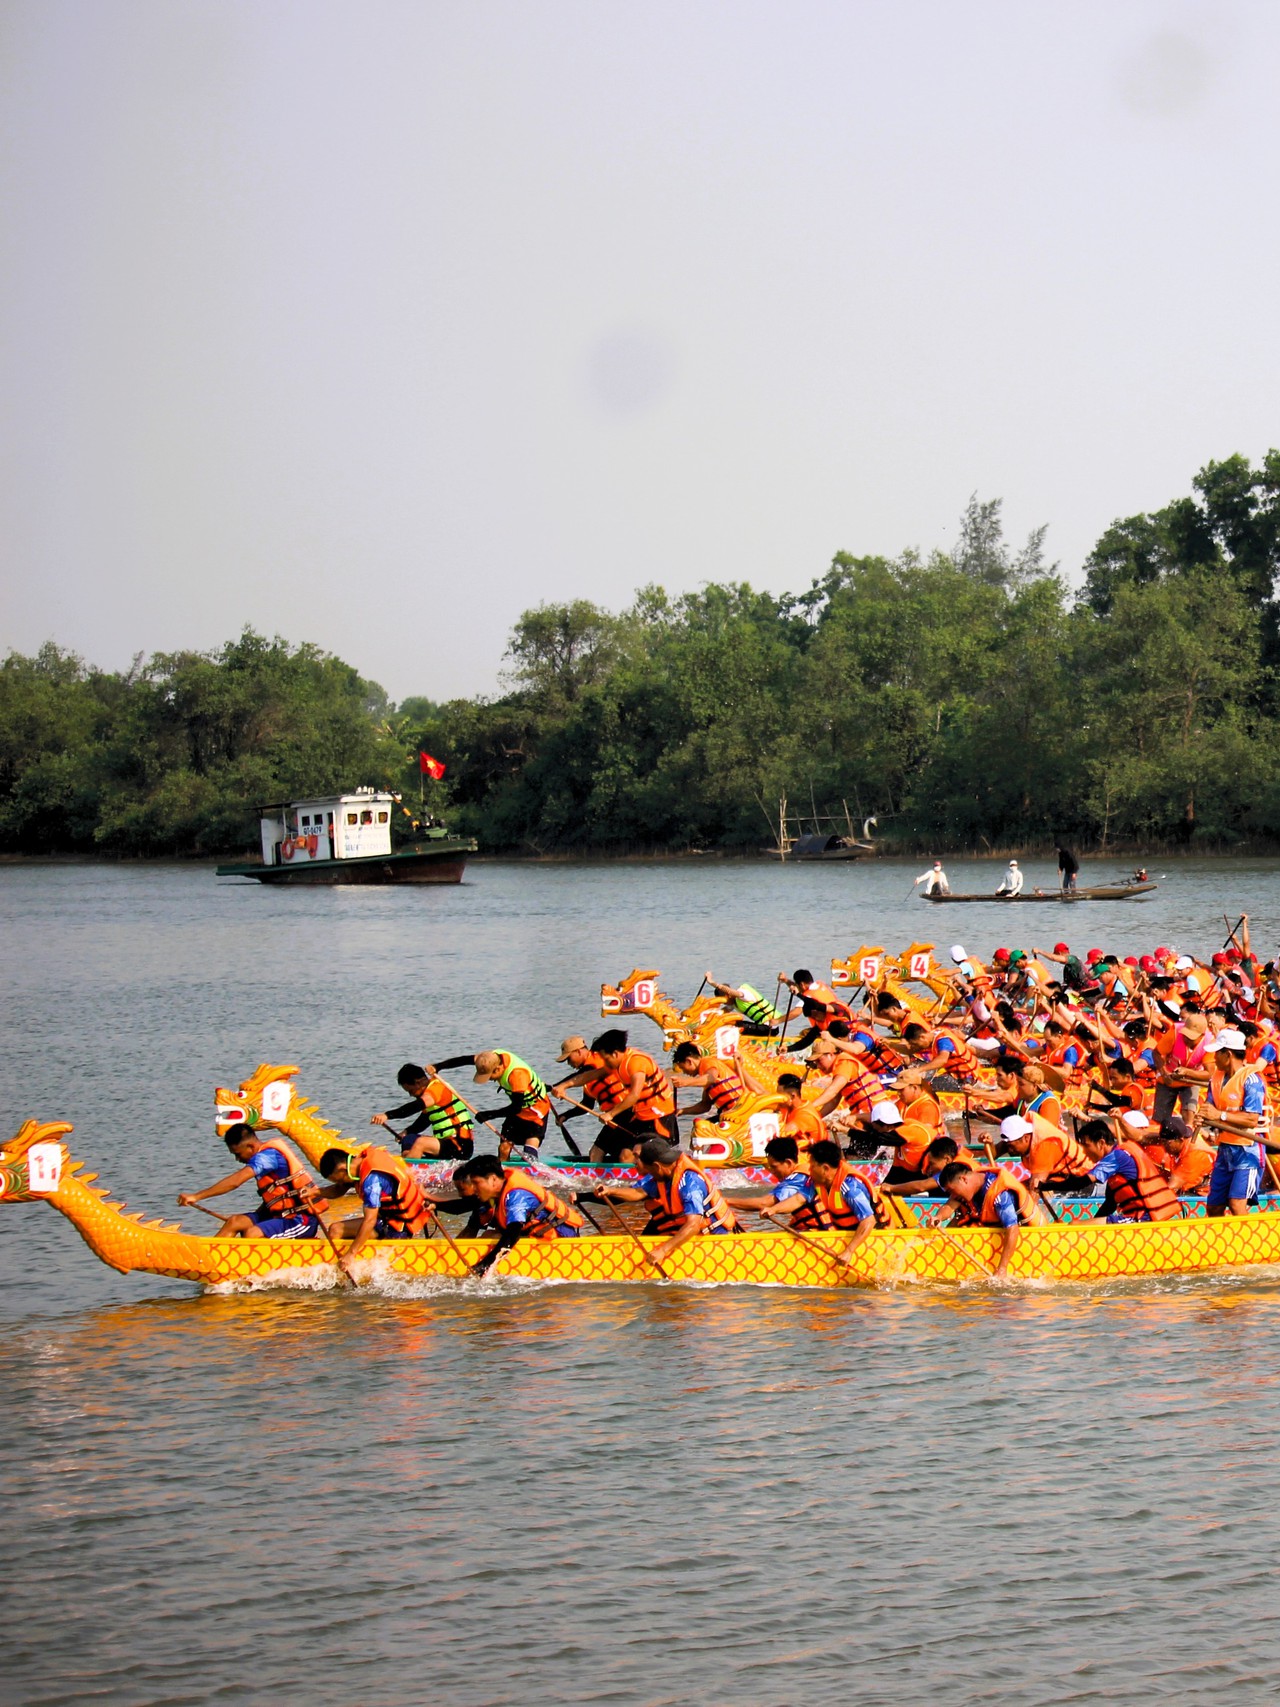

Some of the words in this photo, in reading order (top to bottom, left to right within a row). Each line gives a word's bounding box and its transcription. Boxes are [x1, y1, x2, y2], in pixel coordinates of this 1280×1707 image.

[863, 960, 875, 979] 5
[914, 957, 926, 975] 4
[637, 983, 651, 1005] 6
